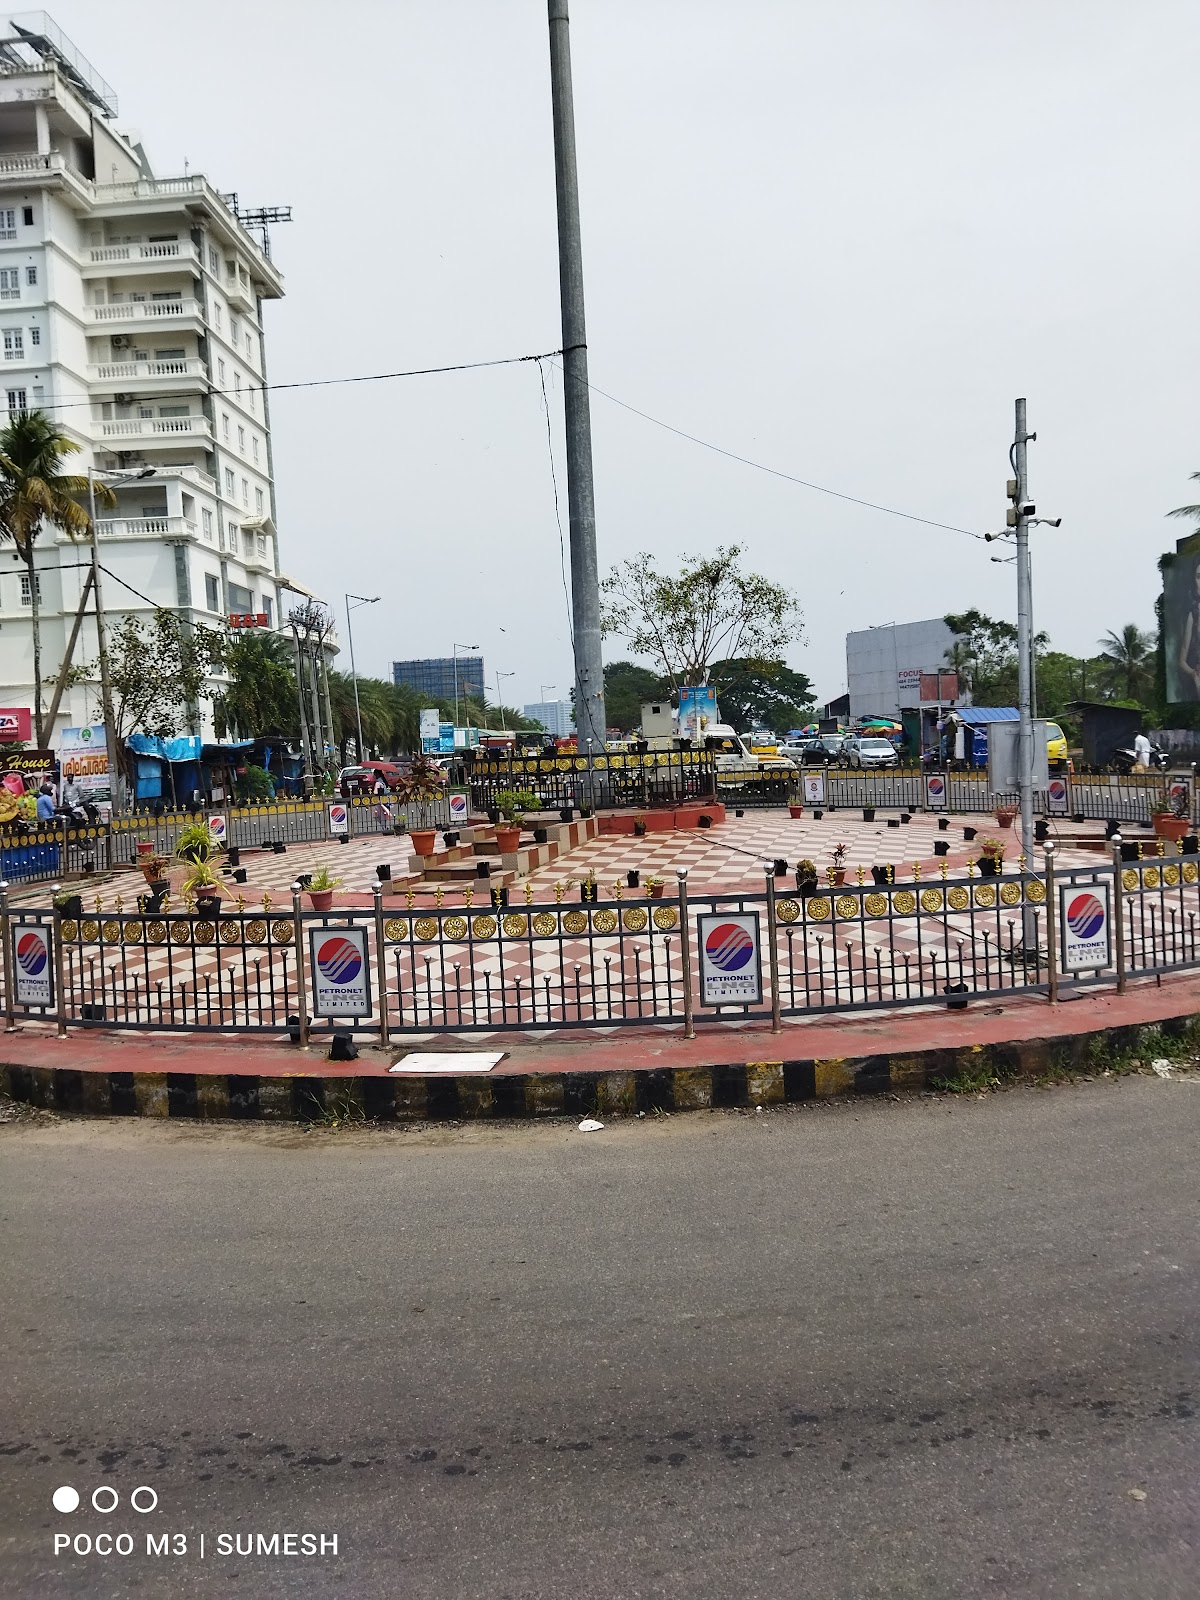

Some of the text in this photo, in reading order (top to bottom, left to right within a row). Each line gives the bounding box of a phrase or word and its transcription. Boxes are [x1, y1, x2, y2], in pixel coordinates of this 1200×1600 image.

[230, 614, 268, 628] BAR
[899, 670, 923, 678] FOCUS
[6, 755, 51, 769] House
[1068, 941, 1105, 949] PETRONET
[1068, 948, 1106, 957] LNG
[1068, 954, 1106, 962] LIMITED
[707, 981, 755, 989] LNG
